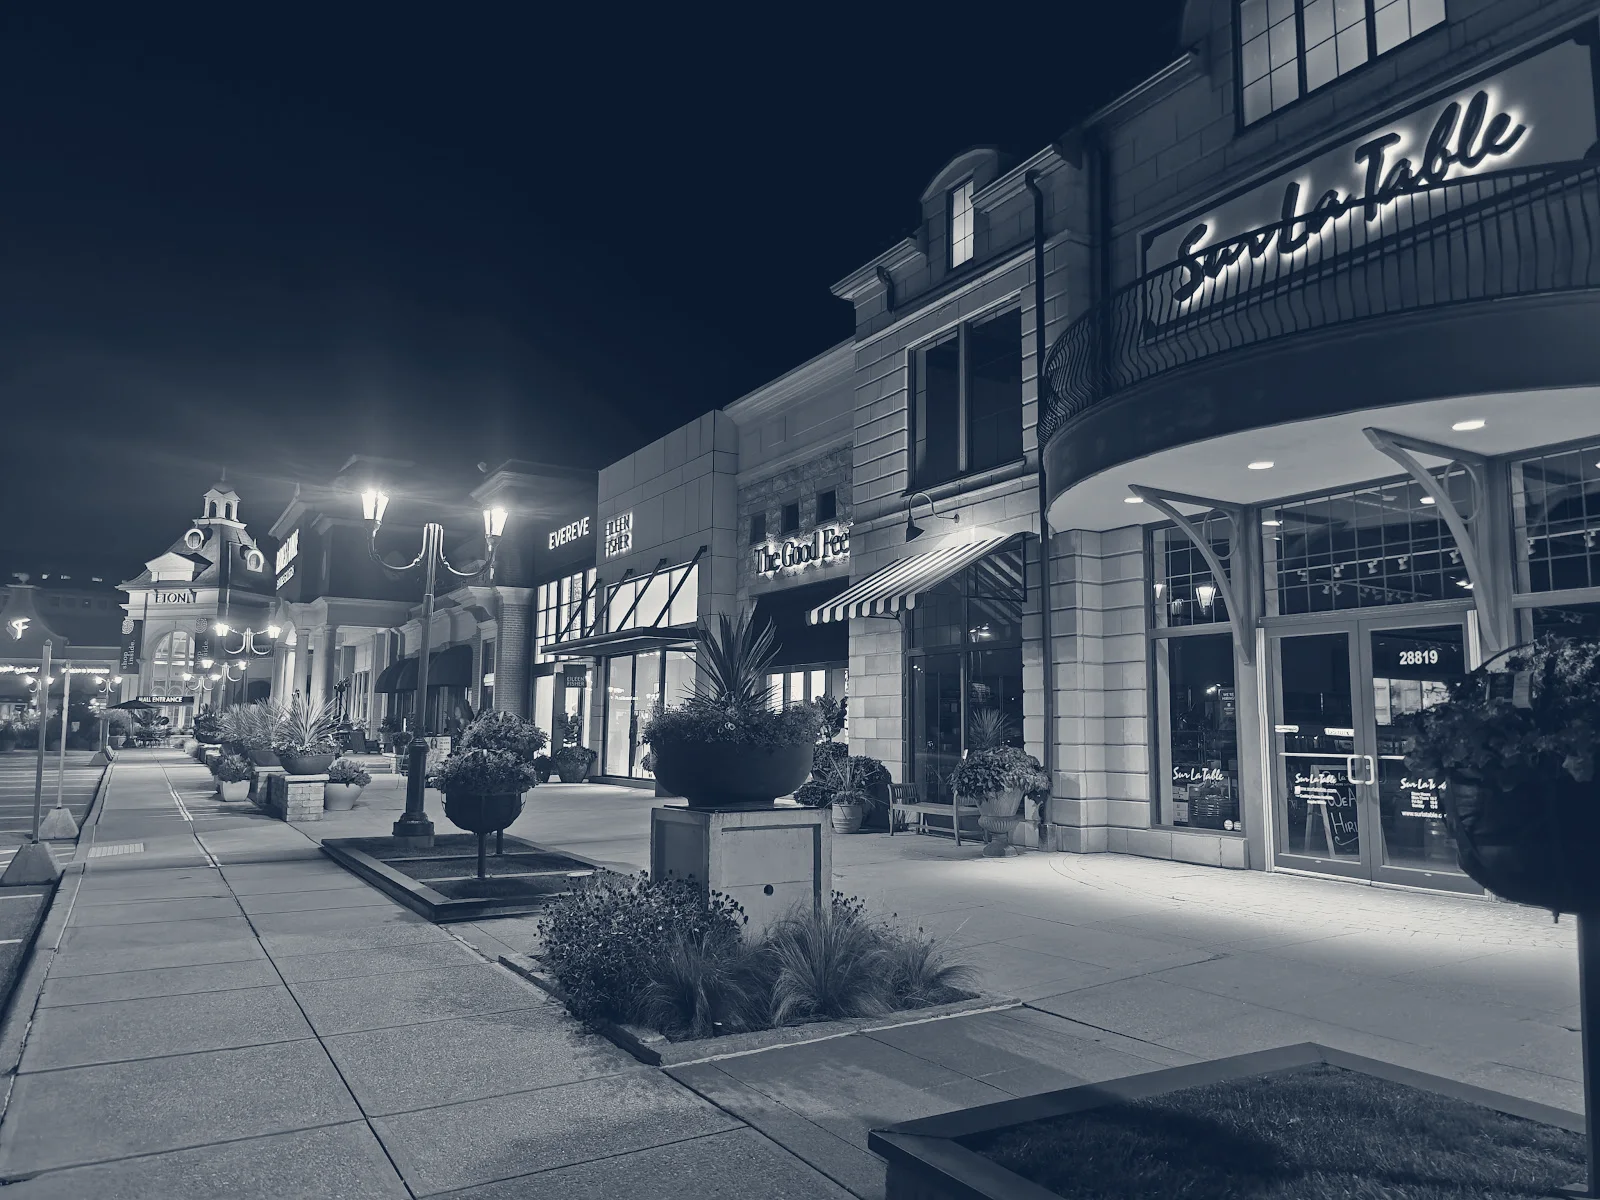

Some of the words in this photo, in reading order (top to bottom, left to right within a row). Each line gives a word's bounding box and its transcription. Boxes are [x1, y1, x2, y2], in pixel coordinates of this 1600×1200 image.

[1278, 181, 1352, 254] La
[1354, 90, 1527, 222] Table
[548, 516, 590, 550] EVEREVE
[754, 545, 780, 573] The
[781, 531, 820, 567] Good
[822, 528, 850, 558] Fee
[121, 651, 129, 670] shop
[1399, 650, 1438, 665] 28819
[1173, 766, 1190, 780] Sur
[1190, 767, 1202, 781] La
[1202, 767, 1224, 782] Table
[1295, 772, 1310, 784] Sur
[1309, 773, 1320, 784] La
[1319, 773, 1337, 785] Table
[1400, 777, 1417, 790] Sur
[1417, 778, 1430, 790] La
